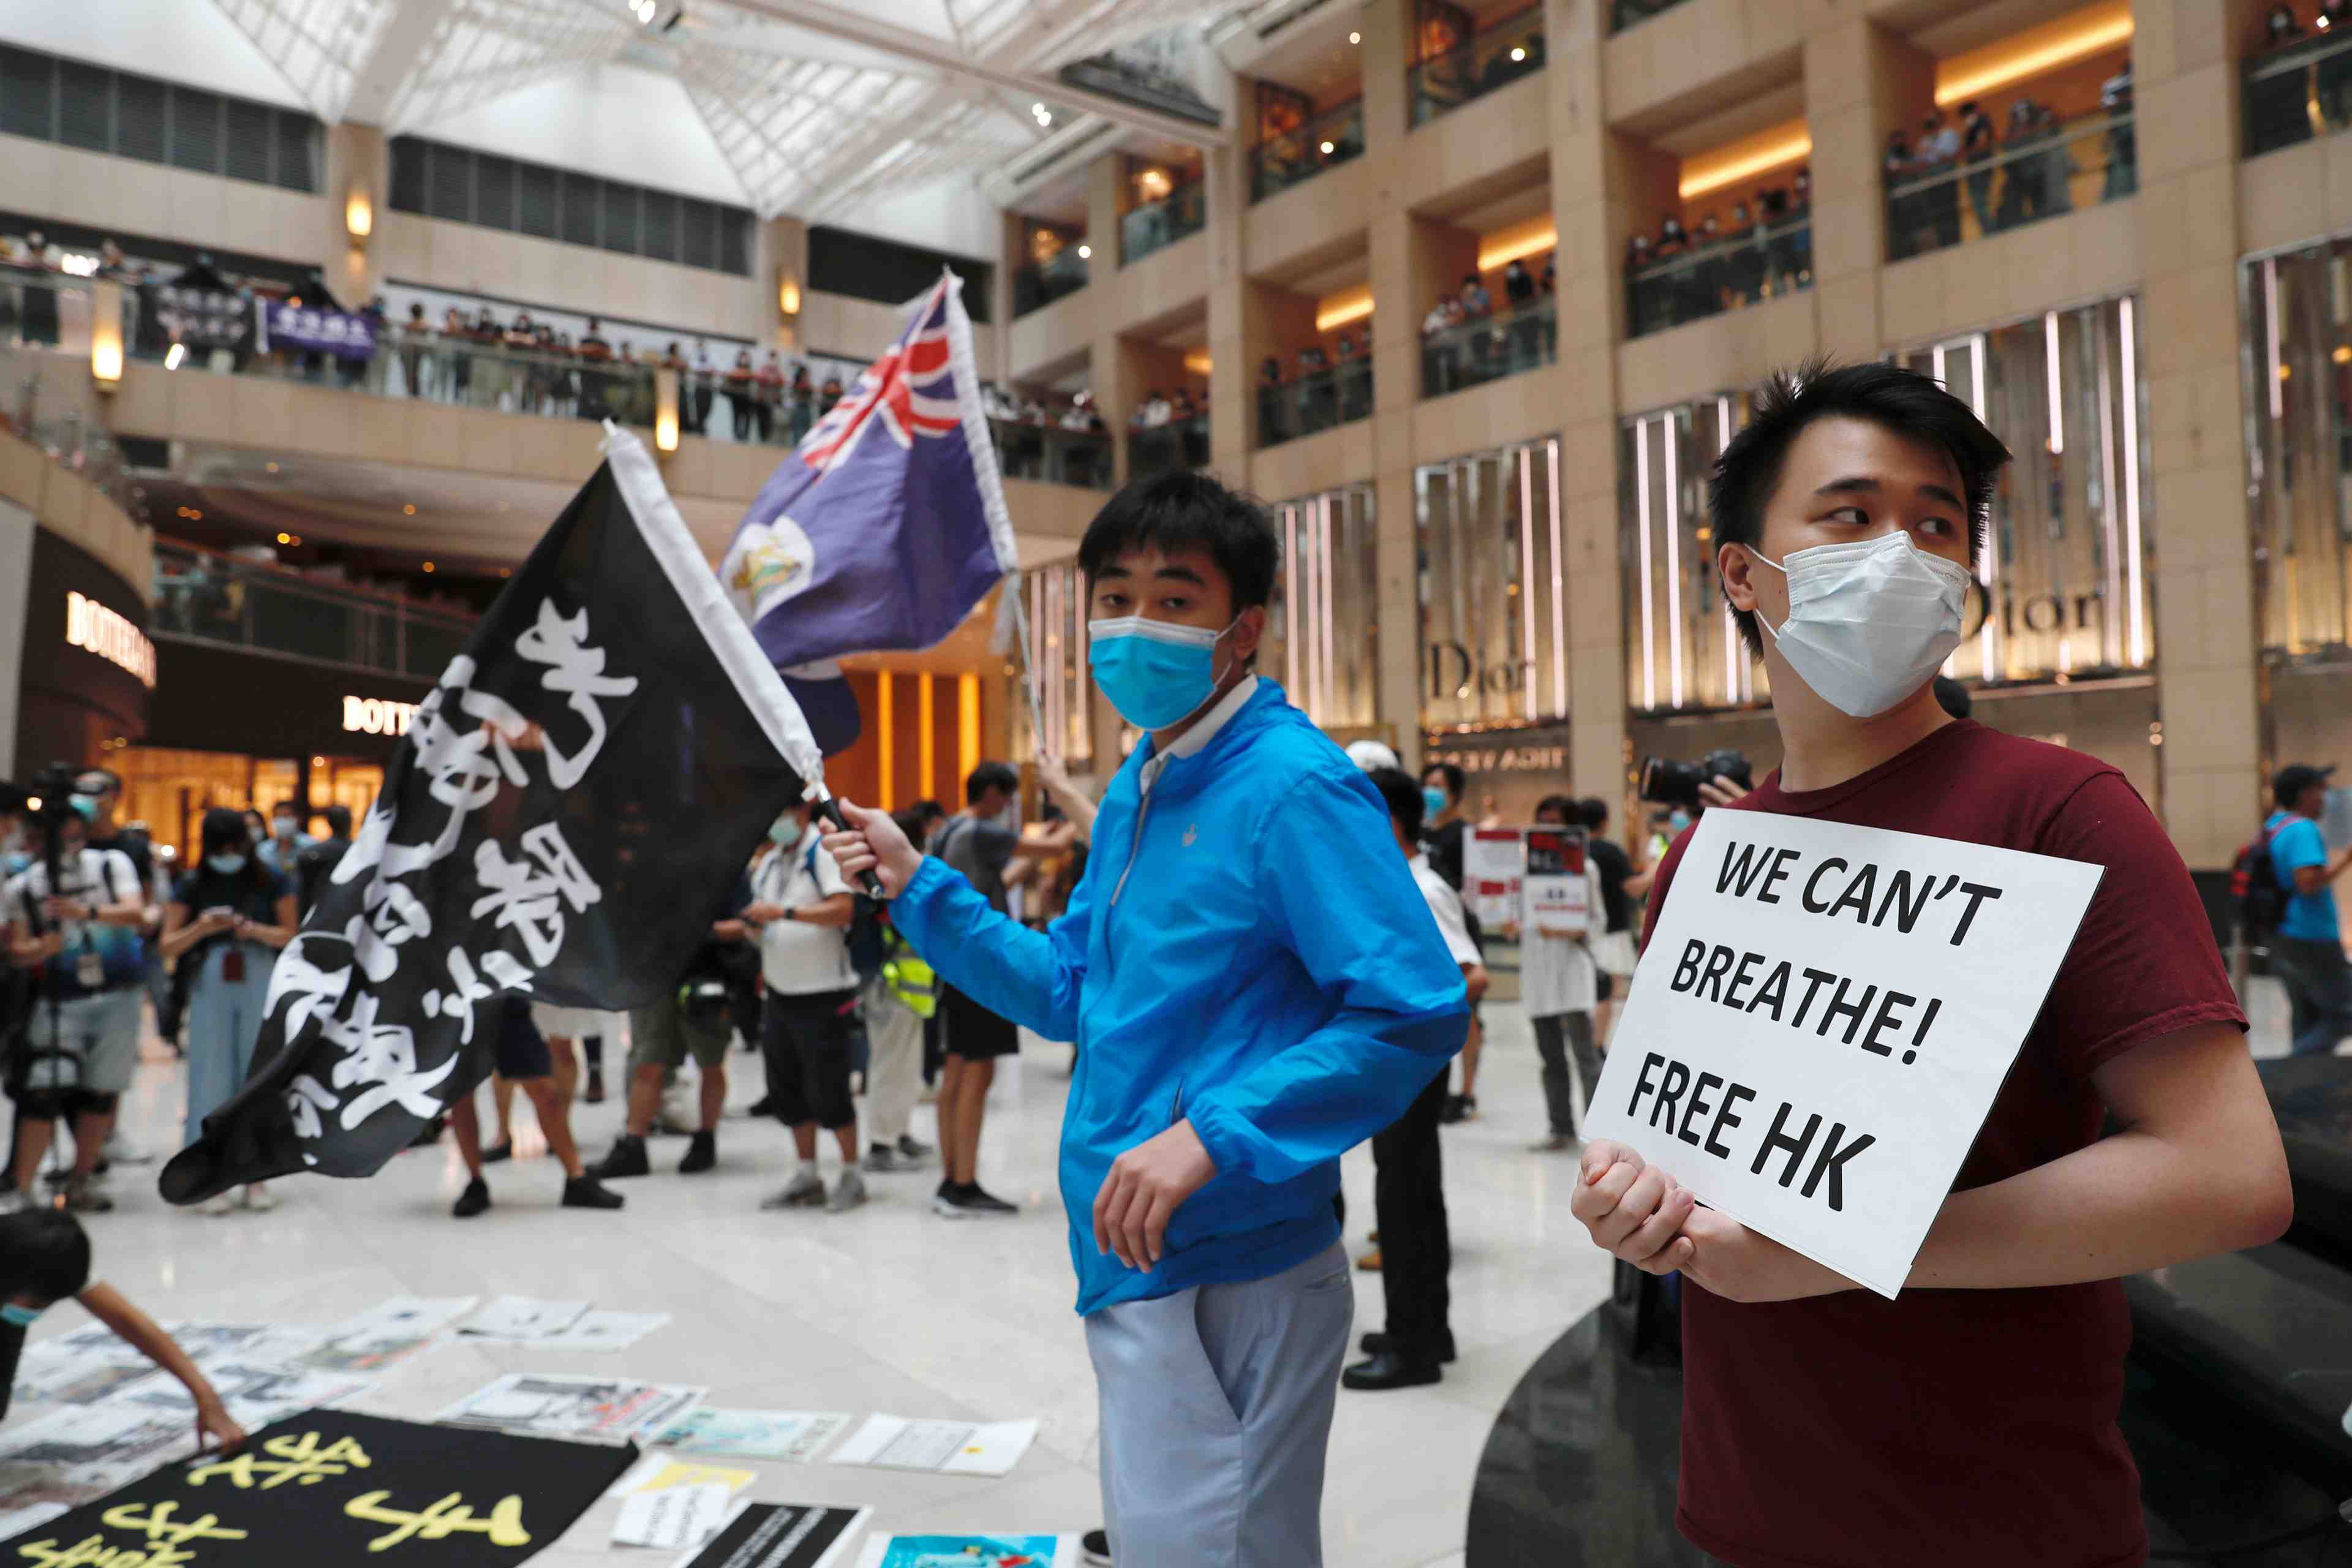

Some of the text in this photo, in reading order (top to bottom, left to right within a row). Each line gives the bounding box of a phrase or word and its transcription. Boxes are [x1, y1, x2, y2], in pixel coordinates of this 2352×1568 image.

[1430, 641, 1533, 698] Dior
[1716, 841, 2003, 946] WE CAN’T
[1670, 938, 1942, 1065] BREATHE!
[1627, 1052, 1876, 1212] FREE HK
